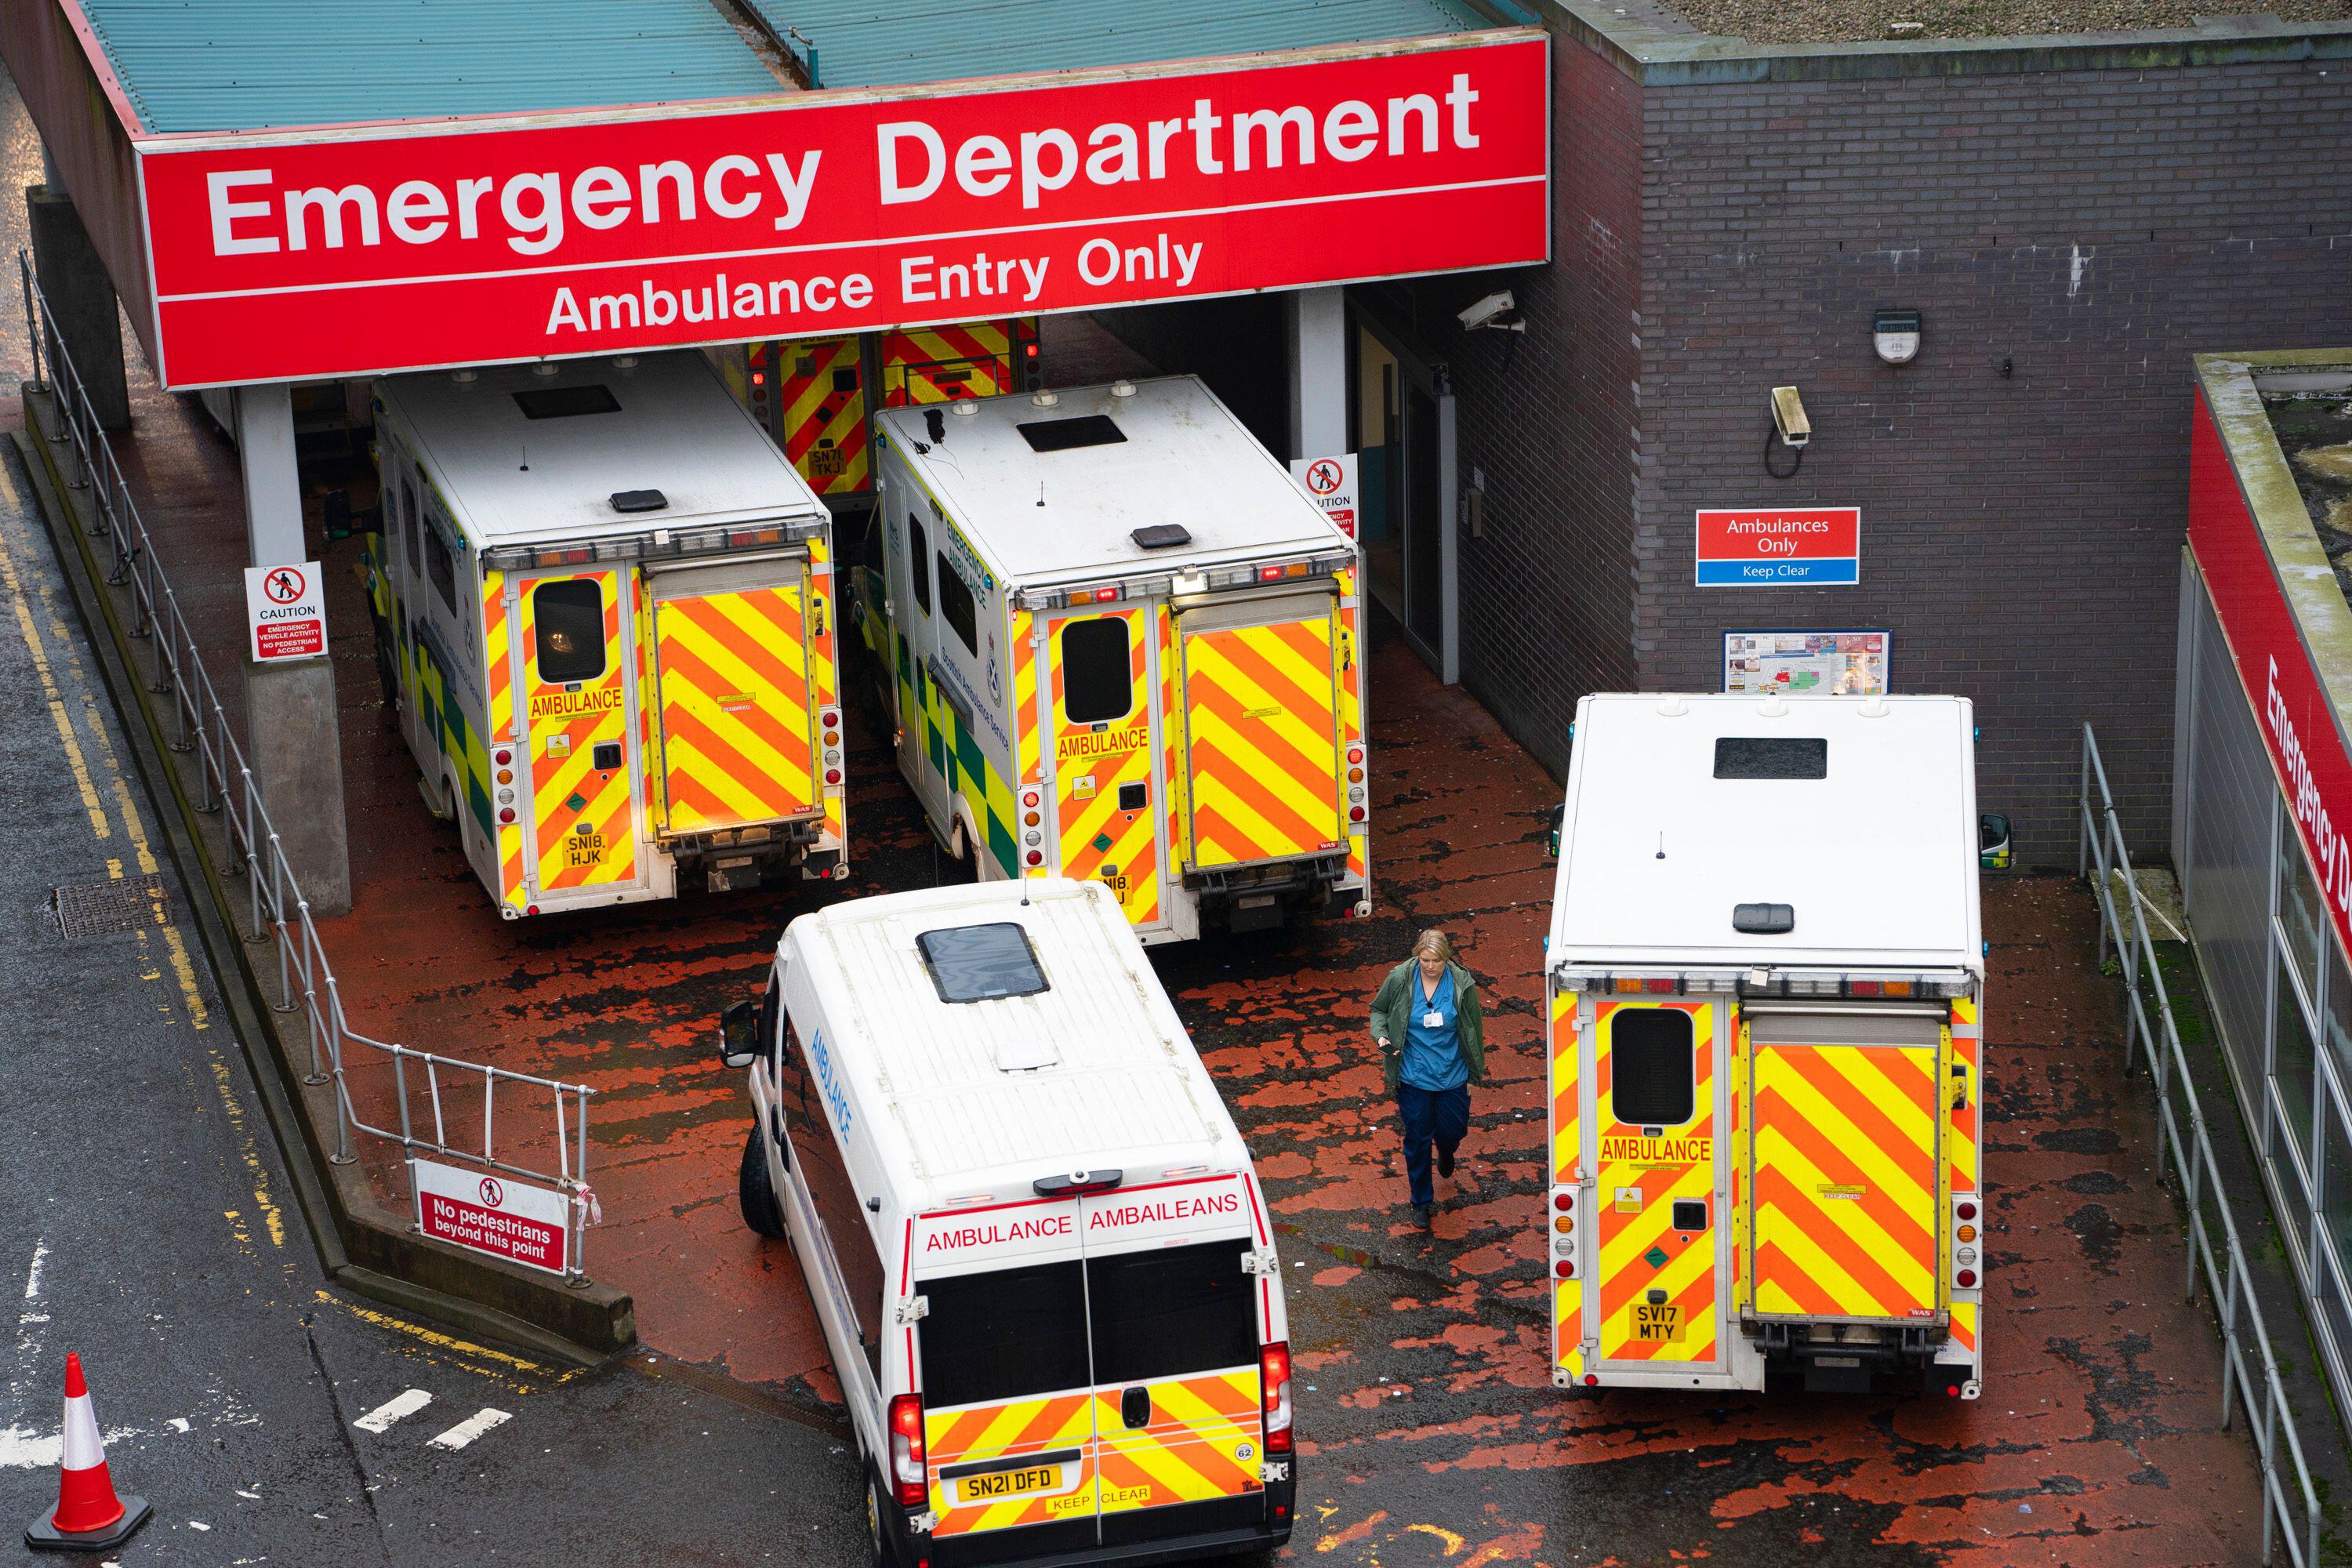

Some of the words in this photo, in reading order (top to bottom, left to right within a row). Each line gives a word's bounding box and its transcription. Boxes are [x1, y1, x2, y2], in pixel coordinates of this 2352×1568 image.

[206, 150, 822, 256] Emergency
[877, 74, 1479, 209] Department
[546, 272, 873, 335] Ambulance
[901, 252, 1049, 304] Entry
[1077, 234, 1203, 288] Only
[1317, 496, 1350, 508] UTION
[1726, 518, 1829, 534] Ambulances
[947, 519, 985, 579] EMERGENCY
[1758, 538, 1798, 556] Only
[949, 546, 986, 611] AMBULANCE
[1743, 566, 1773, 579] Keep
[1777, 565, 1809, 576] Clear
[260, 606, 315, 619] CAUTION
[260, 632, 288, 641] VEHICLE
[289, 630, 319, 638] ACTIVITY
[267, 623, 310, 633] EMERGENCY
[275, 638, 317, 647] PEDESTRIAN
[532, 689, 622, 717] AMBULANCE
[990, 713, 1009, 752] Service
[1058, 728, 1148, 758] AMBULANCE
[2267, 653, 2336, 893] Emergency
[568, 835, 602, 851] SN18
[572, 850, 601, 866] HJK
[811, 1028, 851, 1145] AMBULANCE
[1601, 1139, 1711, 1160] AMBULANCE
[434, 1199, 455, 1218] No
[460, 1208, 550, 1243] pedestrians
[927, 1215, 1072, 1251] AMBULANCE
[1090, 1194, 1238, 1229] AMBAILEANS
[435, 1217, 481, 1242] beyond
[485, 1231, 509, 1248] this
[512, 1240, 545, 1259] point
[1638, 1306, 1677, 1322] SV17
[1640, 1324, 1675, 1339] MTY
[968, 1475, 1009, 1497] SN21
[1015, 1469, 1051, 1490] DFD
[1054, 1496, 1090, 1510] KEEP
[1101, 1488, 1148, 1504] CLEAR
